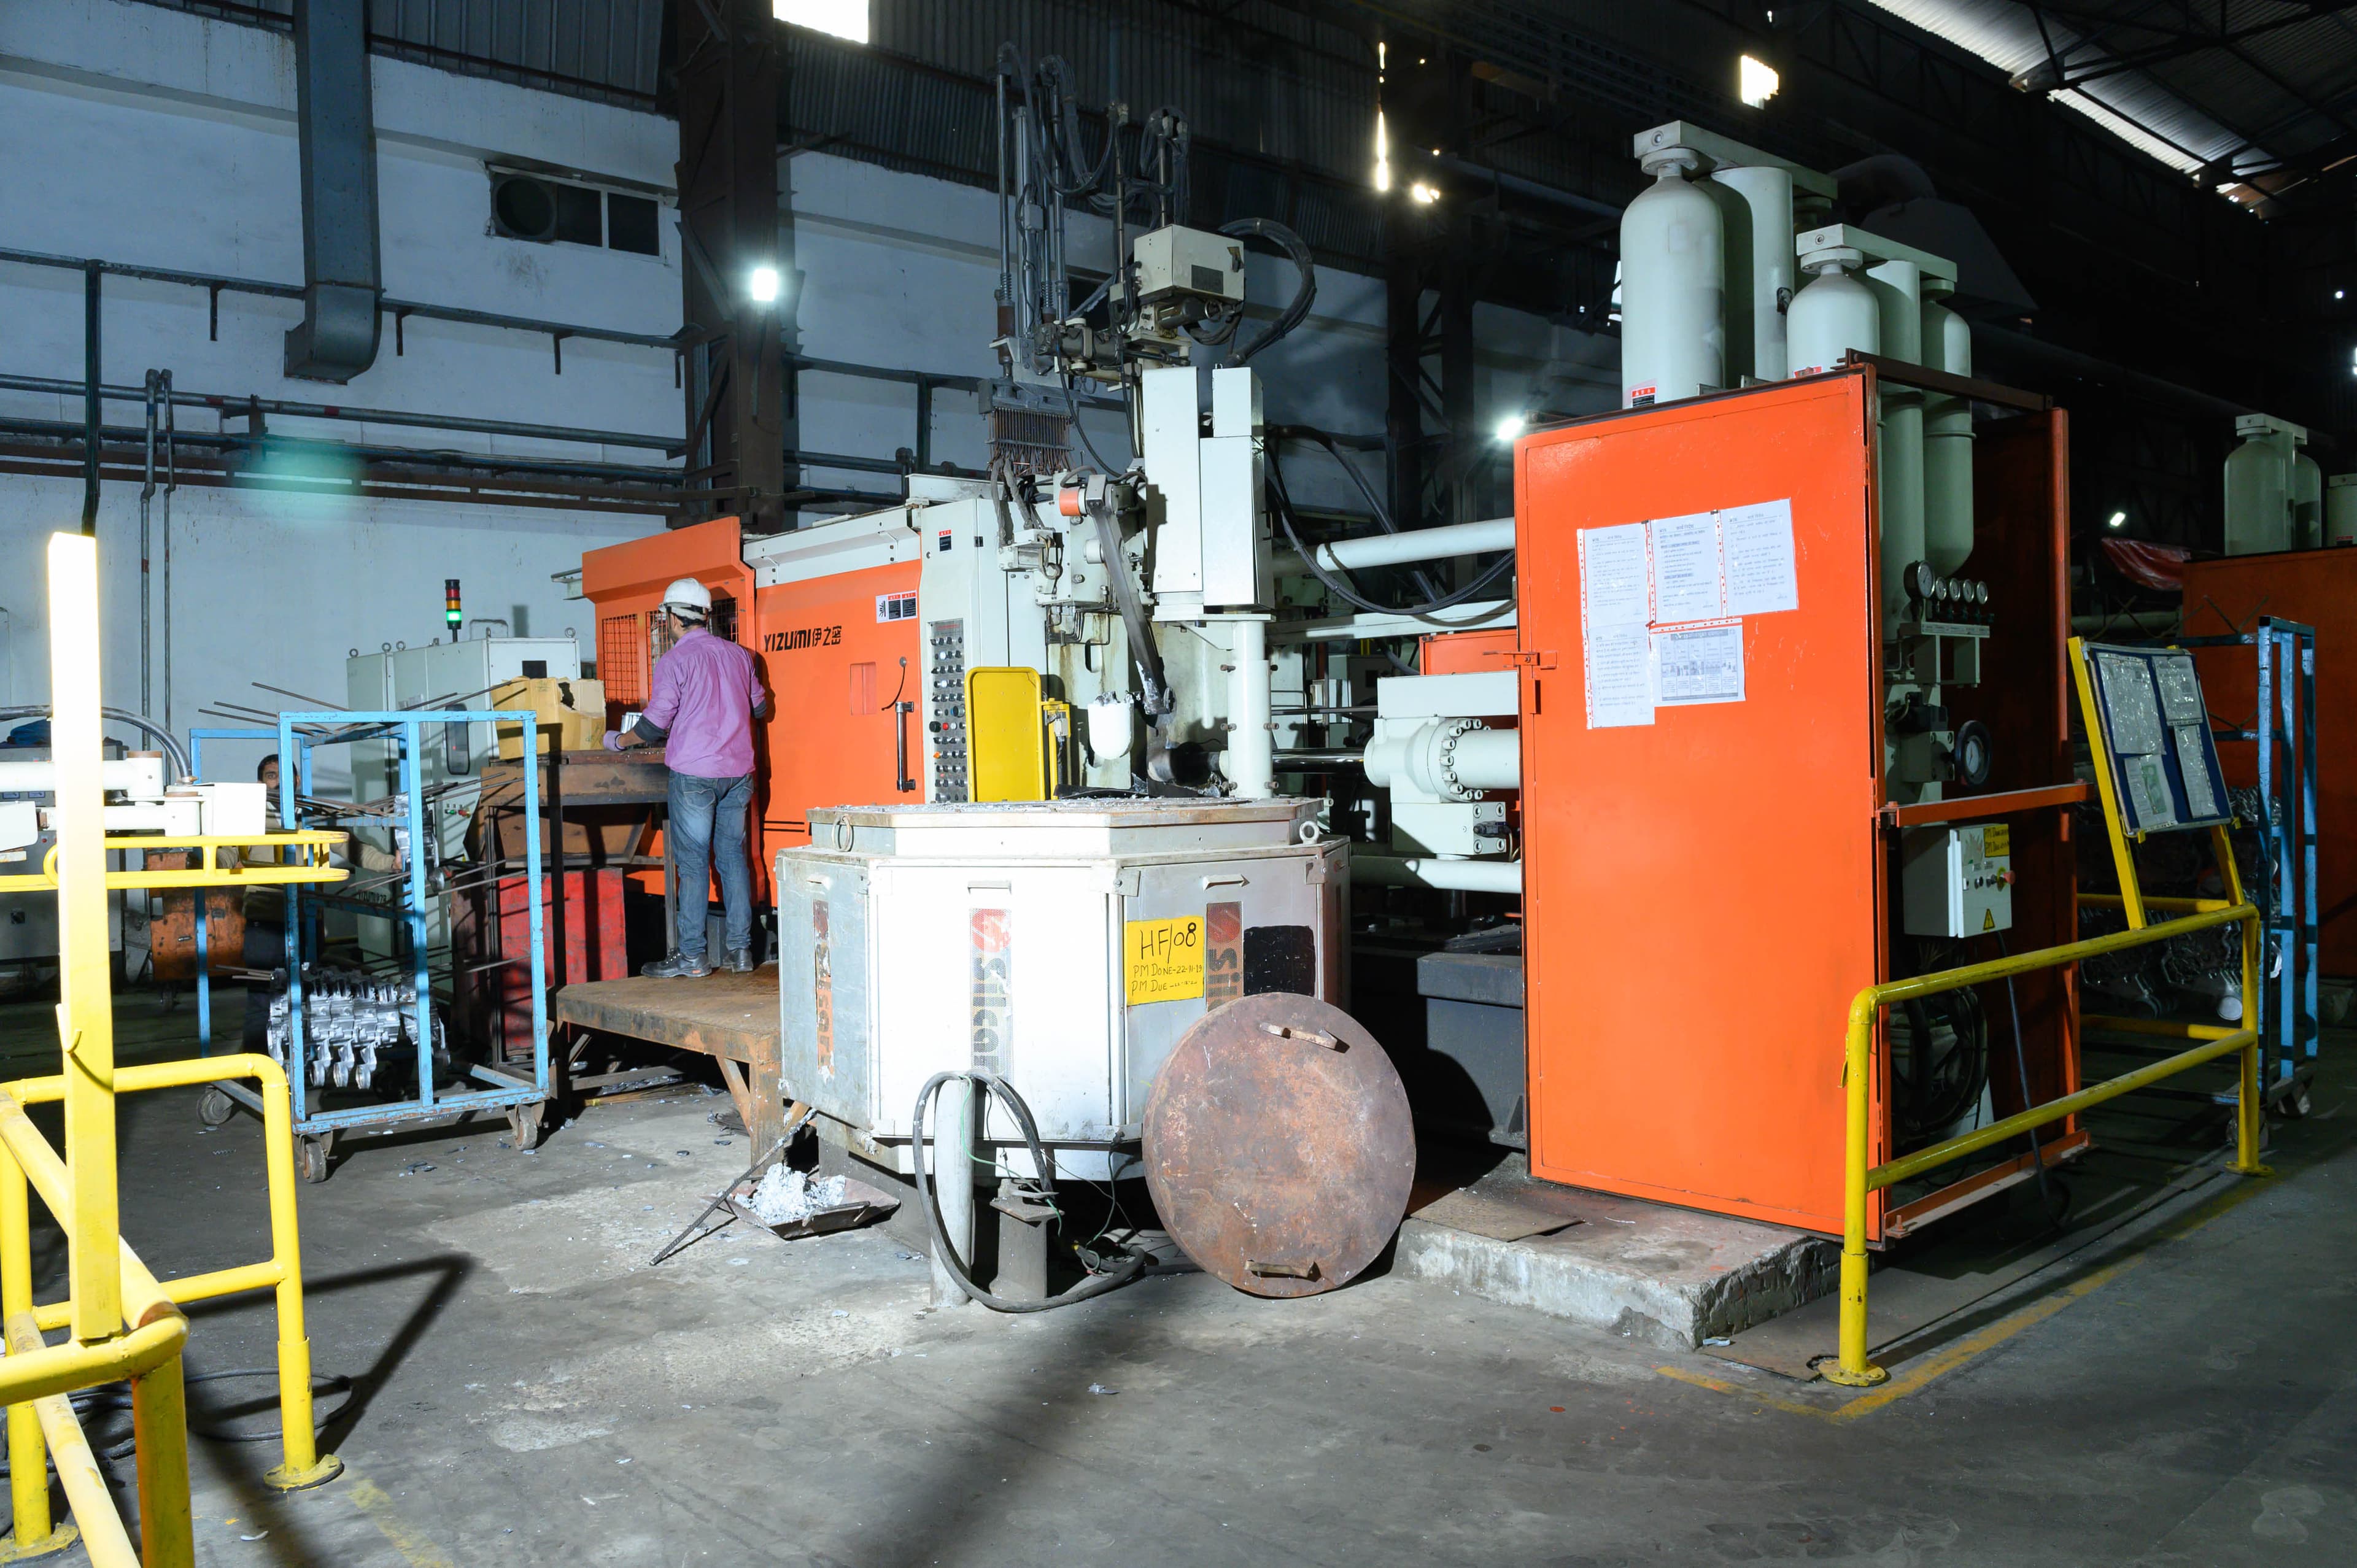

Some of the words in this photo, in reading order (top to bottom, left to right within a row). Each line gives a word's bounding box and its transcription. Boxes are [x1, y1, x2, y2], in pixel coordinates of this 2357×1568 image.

[764, 629, 811, 652] YIZUMI
[1140, 922, 1196, 964] HF/08
[1133, 965, 1149, 978] PM
[1131, 980, 1147, 996] PM
